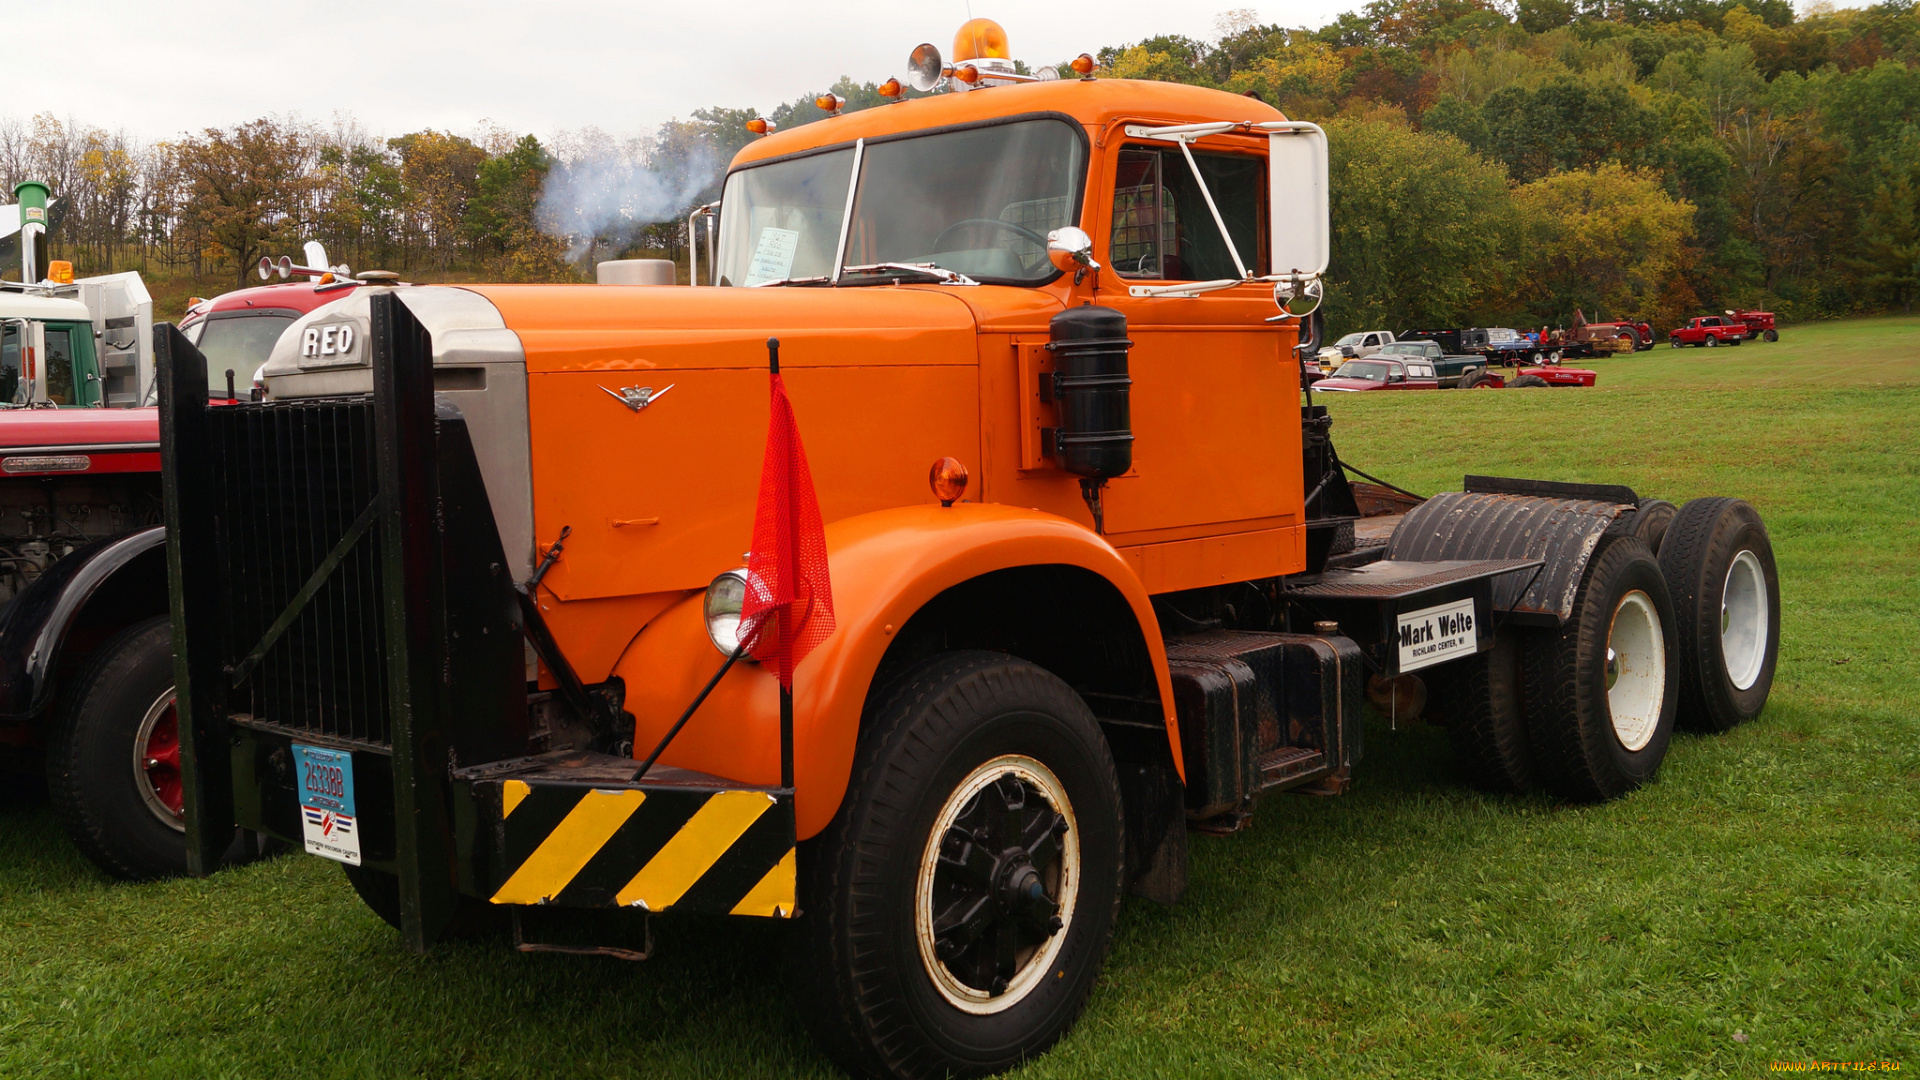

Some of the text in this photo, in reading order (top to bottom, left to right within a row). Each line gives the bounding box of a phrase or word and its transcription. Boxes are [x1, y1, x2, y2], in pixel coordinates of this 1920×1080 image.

[303, 325, 353, 357] REO
[7, 457, 86, 471] HENDRICKSON
[1400, 612, 1473, 648] Mark Welte
[1413, 636, 1465, 658] RICHLAND CENTER, WI
[313, 795, 340, 810] WISCONSIN
